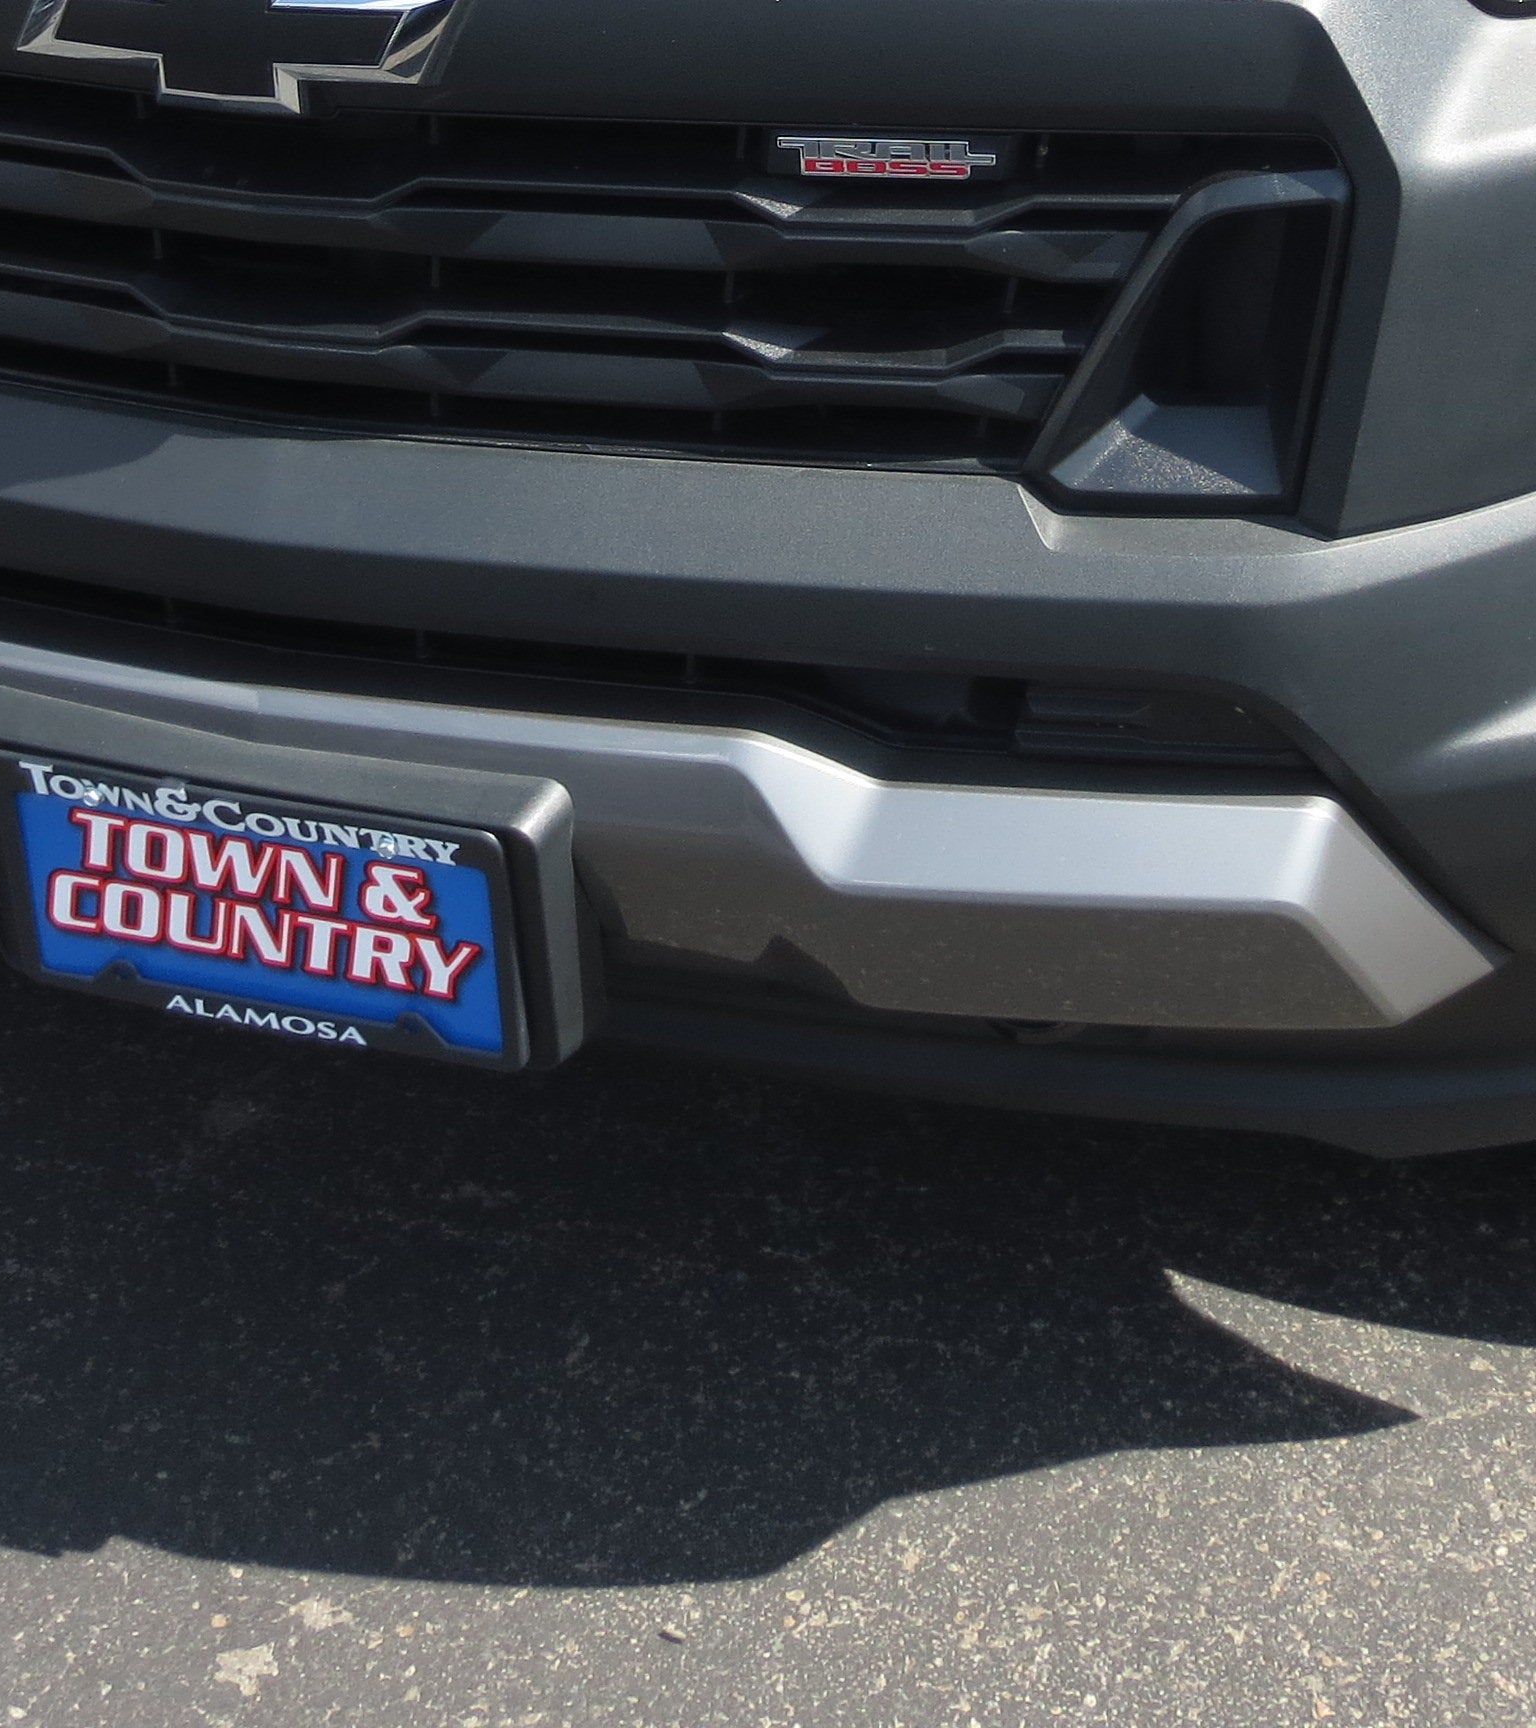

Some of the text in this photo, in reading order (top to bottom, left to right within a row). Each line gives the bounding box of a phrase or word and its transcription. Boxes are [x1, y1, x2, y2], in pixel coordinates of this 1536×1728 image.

[777, 136, 996, 166] TRAIL
[802, 159, 971, 179] BOSS
[68, 807, 437, 930] TOWN &
[47, 869, 481, 1000] COUNTRY
[165, 993, 368, 1047] ALAMOSA
